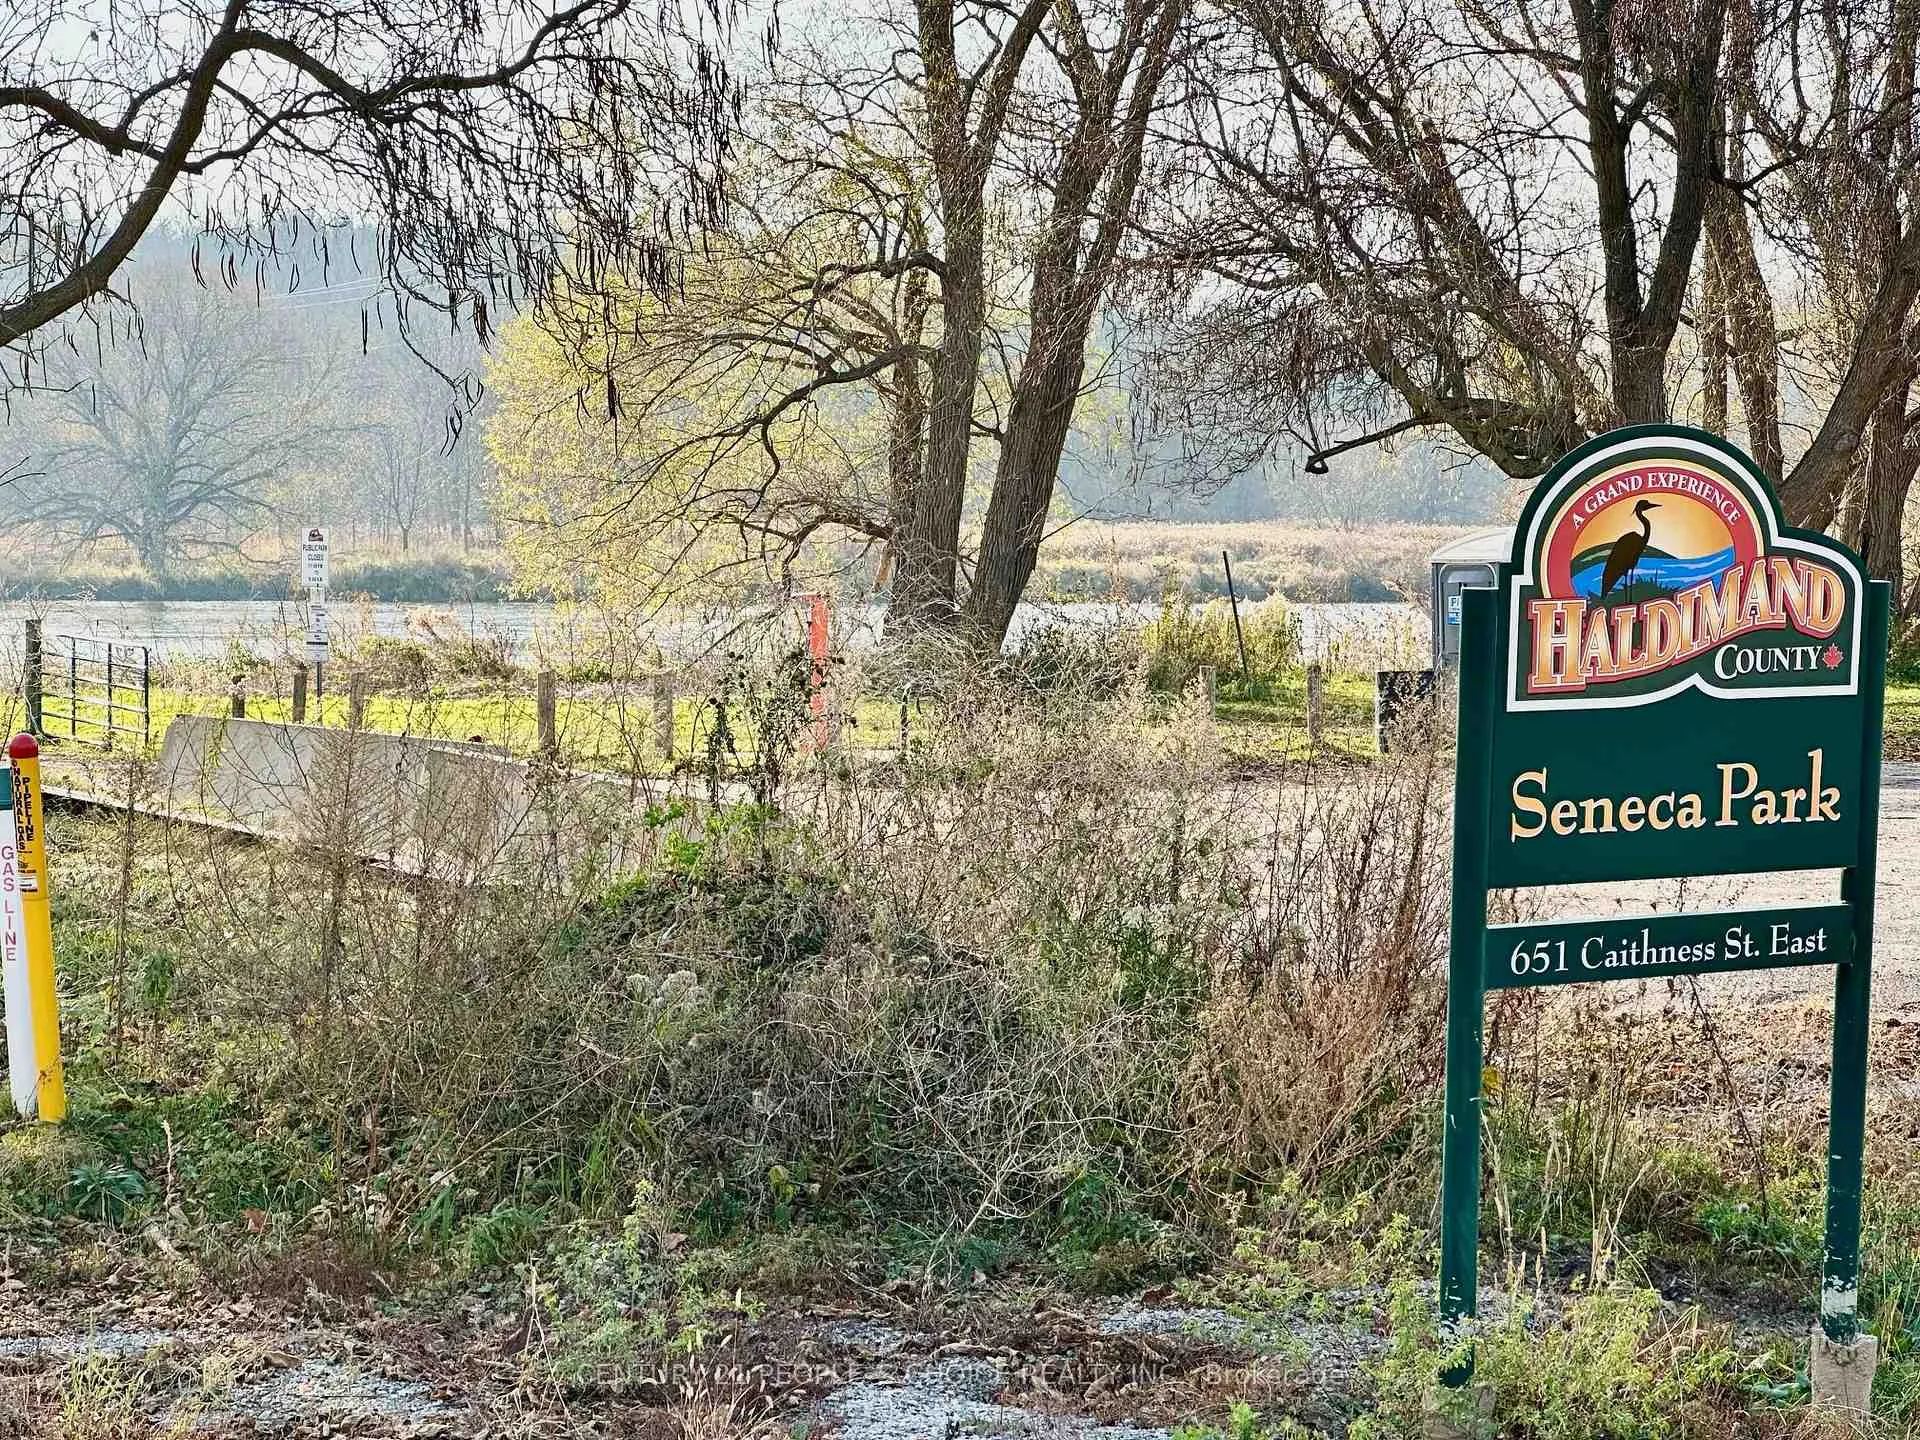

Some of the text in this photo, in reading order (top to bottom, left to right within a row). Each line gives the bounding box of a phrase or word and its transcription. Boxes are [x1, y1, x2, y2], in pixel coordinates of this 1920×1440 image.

[1571, 472, 1741, 530] A GRAND EXPERIENCE
[1529, 556, 1846, 690] HALDIMAND
[1714, 644, 1823, 680] COUNTY
[13, 767, 24, 825] NATURAL
[22, 777, 34, 841] PIPELINE
[1510, 748, 1842, 843] Seneca Park
[17, 825, 26, 850] GAS
[1, 845, 17, 961] GAS LINE
[1510, 921, 1828, 975] 651 Caithness St. East
